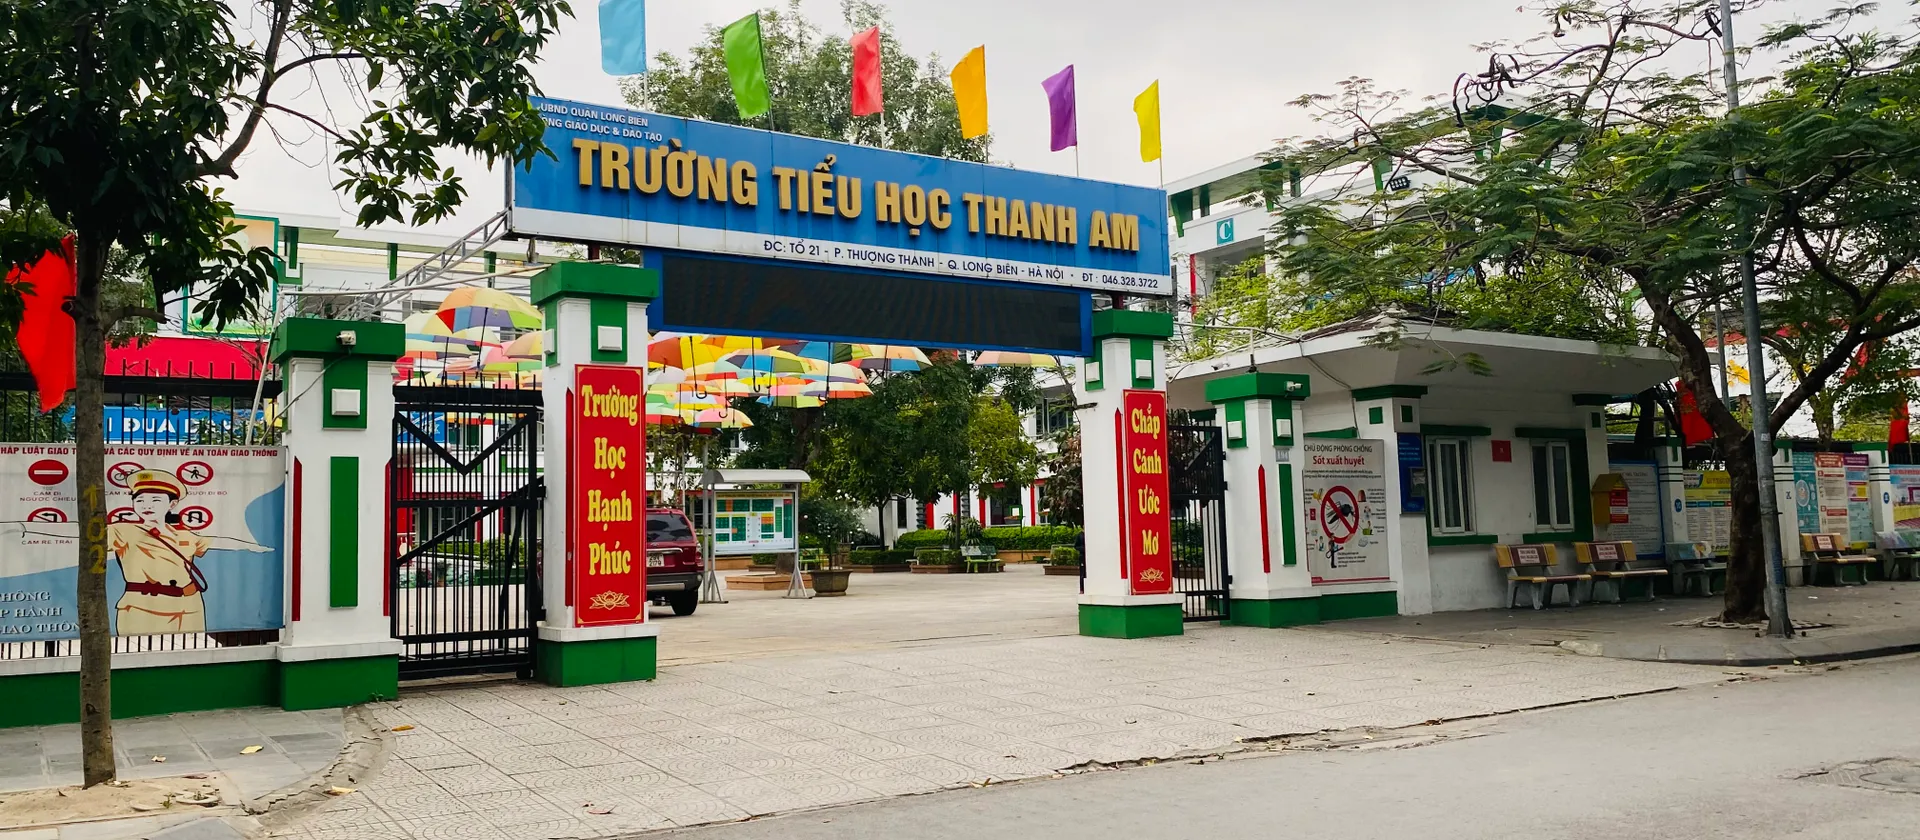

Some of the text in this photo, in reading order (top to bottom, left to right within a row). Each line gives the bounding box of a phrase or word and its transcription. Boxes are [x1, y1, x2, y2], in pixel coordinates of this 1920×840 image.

[540, 103, 648, 127] UBND QUẬN LONG BIÊN
[541, 115, 662, 143] ÒNG GIÁO DỤC & ĐÀO TẠO
[572, 137, 1140, 252] TRƯỜNG TIỂU HỌC THANH AM
[1219, 221, 1232, 240] C
[764, 240, 786, 253] ĐC:
[789, 239, 805, 255] TỔ
[809, 245, 820, 256] 21
[834, 248, 844, 259] P.
[848, 249, 896, 265] THƯỢNG
[898, 254, 935, 267] THANH
[948, 259, 960, 270] Q.
[962, 261, 993, 273] LONG
[996, 263, 1018, 275] BIÊN
[1028, 265, 1043, 278] HÀ
[1045, 267, 1064, 282] NỘI
[1102, 274, 1158, 289] 046.328.3722
[582, 384, 638, 426] Trường
[1131, 403, 1160, 439] Chắp
[0, 447, 19, 455] HÁP
[22, 446, 45, 457] LUẬT
[47, 447, 69, 455] GIAO
[117, 447, 135, 456] CÁC
[137, 448, 154, 457] QUY
[157, 448, 178, 458] ĐỊNH
[192, 449, 205, 457] AN
[207, 448, 228, 457] TOÀN
[230, 449, 250, 457] GIAO
[252, 449, 278, 457] THÔNG
[594, 437, 626, 479] Học
[1133, 447, 1162, 474] Cánh
[1313, 455, 1365, 467] Sốt xuất huyết
[1316, 444, 1332, 453] ĐỘNG
[1333, 444, 1353, 453] PHÒNG
[1353, 443, 1373, 453] CHỐNG
[587, 489, 632, 531] Hạnh
[1138, 484, 1160, 515] Ước
[1142, 529, 1159, 555] Mơ
[589, 541, 631, 576] Phúc
[0, 590, 51, 602] HÔNG
[14, 606, 62, 618] HÀNH
[0, 621, 80, 635] IAO THÔN
